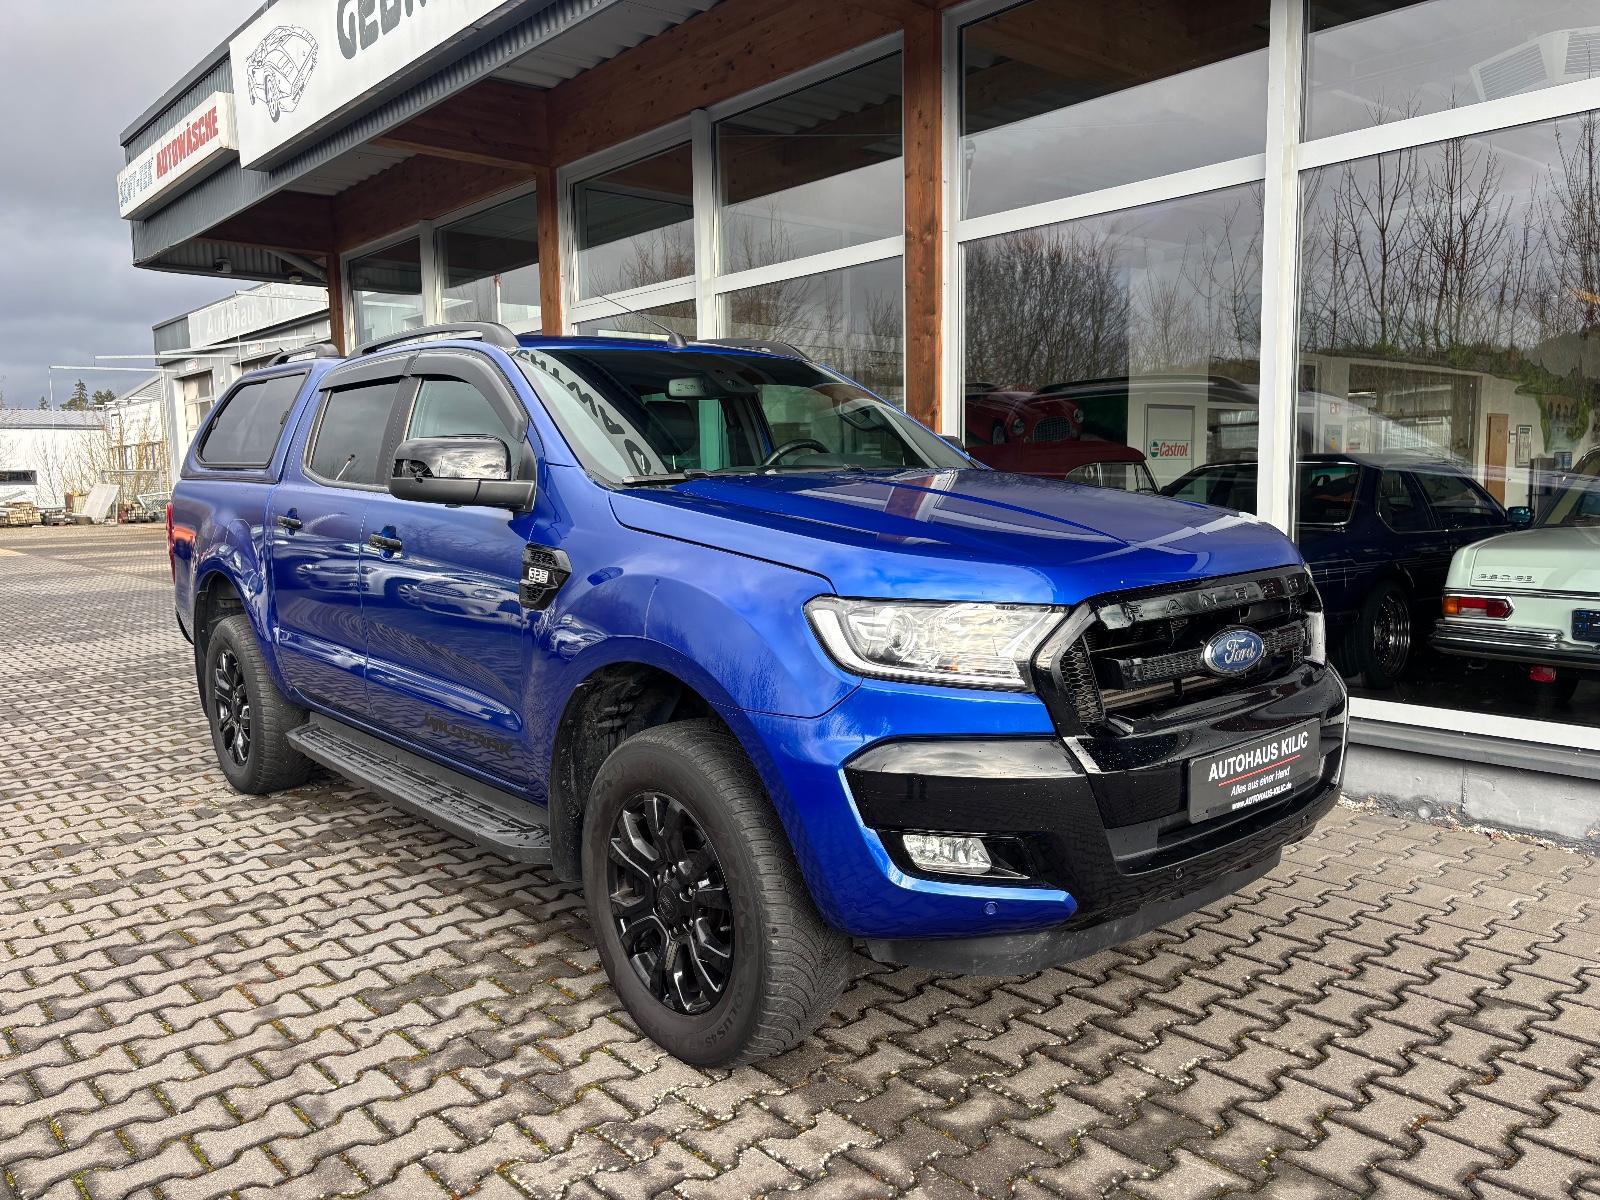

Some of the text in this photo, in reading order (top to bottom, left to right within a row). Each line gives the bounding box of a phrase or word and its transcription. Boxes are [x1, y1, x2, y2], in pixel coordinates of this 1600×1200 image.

[156, 105, 219, 180] AUTOWÄSCHE
[1160, 442, 1189, 457] Castrol
[1223, 637, 1256, 664] Ford
[1208, 731, 1309, 782] AUTOHAUS KILIC
[1230, 765, 1291, 797] Alles aus einer Hand
